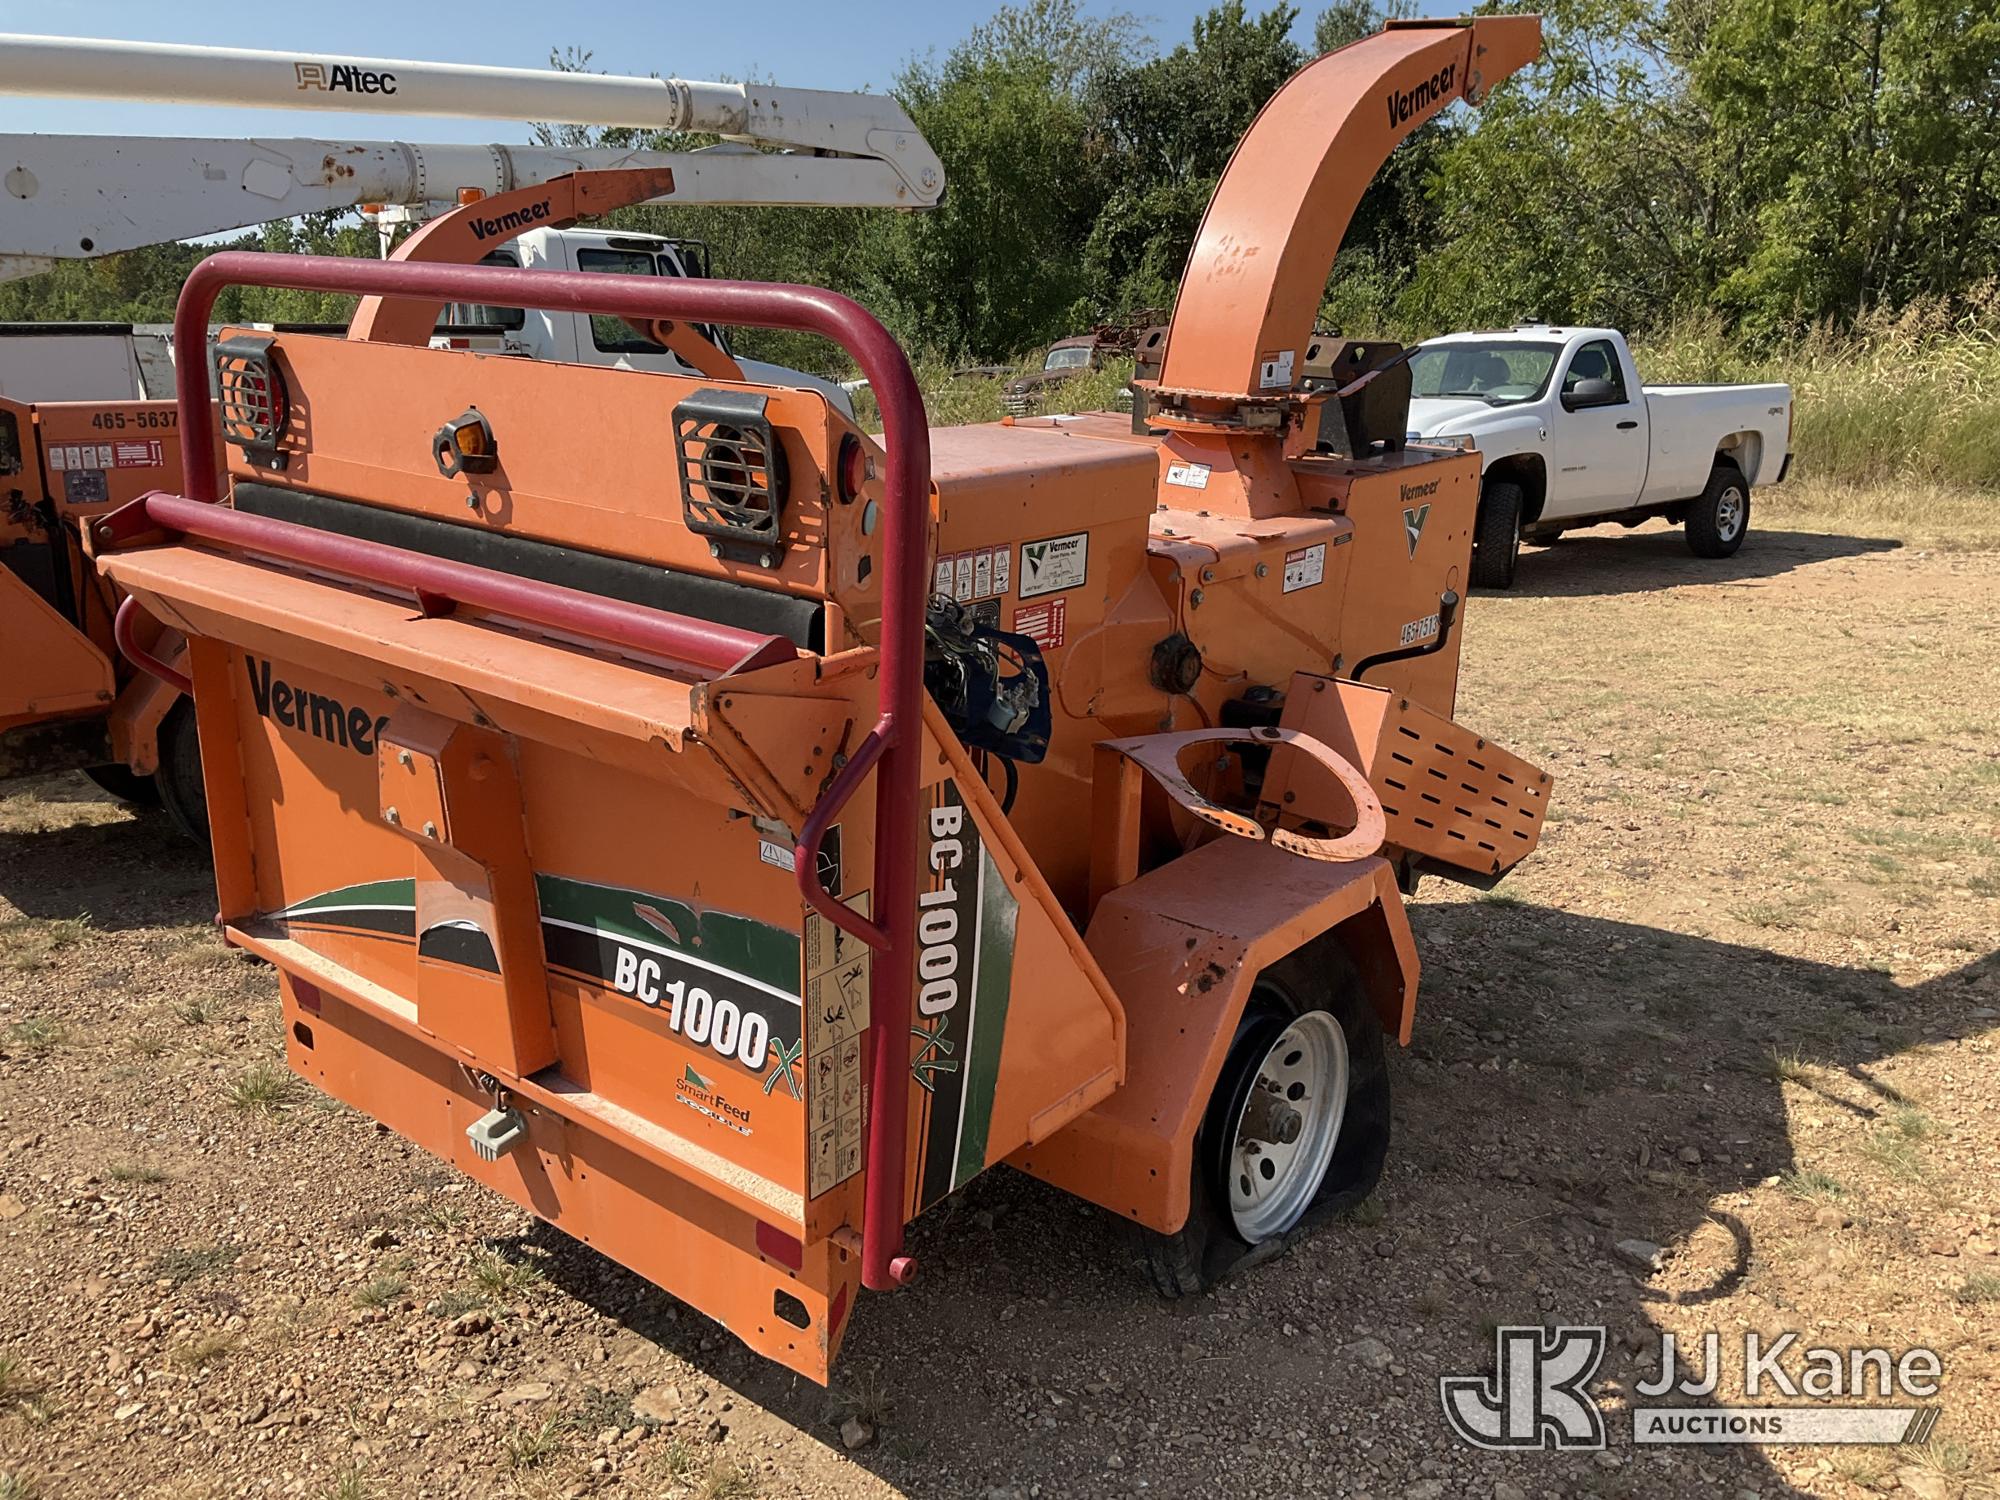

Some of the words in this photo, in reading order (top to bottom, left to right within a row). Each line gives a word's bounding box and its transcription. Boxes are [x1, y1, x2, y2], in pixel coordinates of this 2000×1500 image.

[329, 64, 397, 94] Altec
[1387, 63, 1456, 129] Vermeer
[468, 200, 551, 240] Vermeer
[92, 411, 178, 429] 465-5637
[1400, 481, 1439, 501] Vermeer
[1049, 540, 1079, 552] Vermeer
[676, 1078, 752, 1123] SmartFeed
